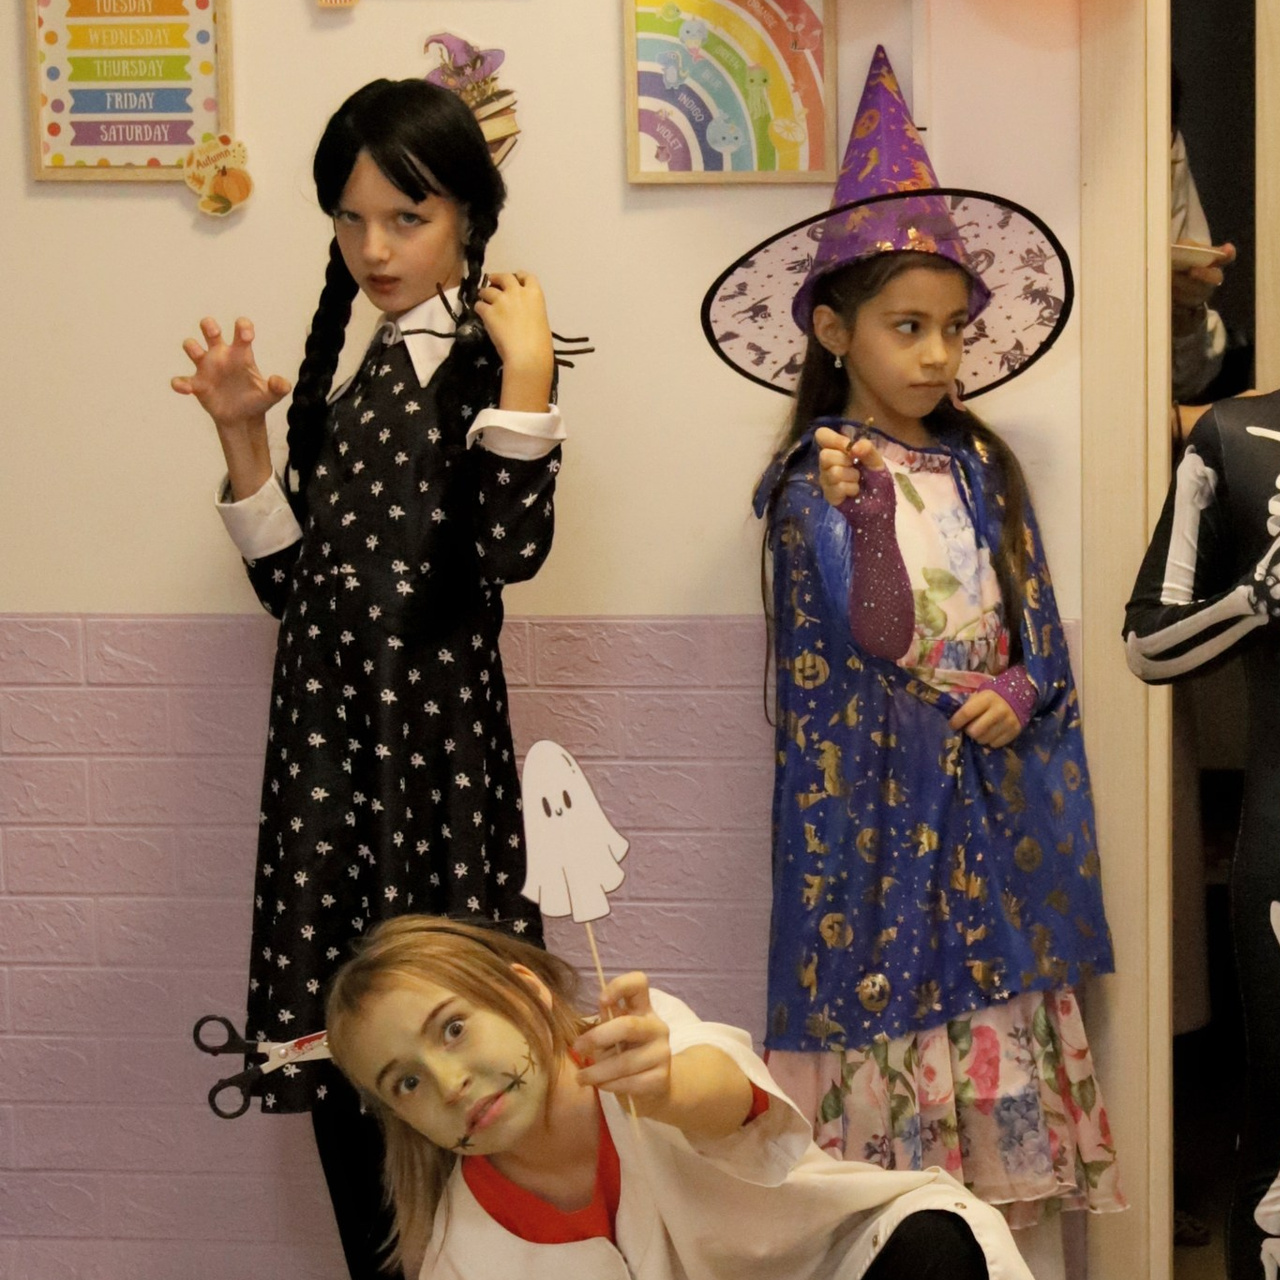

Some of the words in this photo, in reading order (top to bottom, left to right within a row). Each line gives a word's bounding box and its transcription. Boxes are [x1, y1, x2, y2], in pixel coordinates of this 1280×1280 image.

[88, 28, 171, 46] WEDNESDAY
[93, 59, 165, 77] THURSDAY
[714, 45, 741, 70] GREEN
[701, 68, 722, 89] BLUE
[105, 92, 155, 110] FRIDAY
[677, 92, 705, 122] INDIGO
[100, 124, 170, 142] SATURDAY
[656, 123, 683, 151] VIOLET
[196, 149, 232, 170] Autumn
